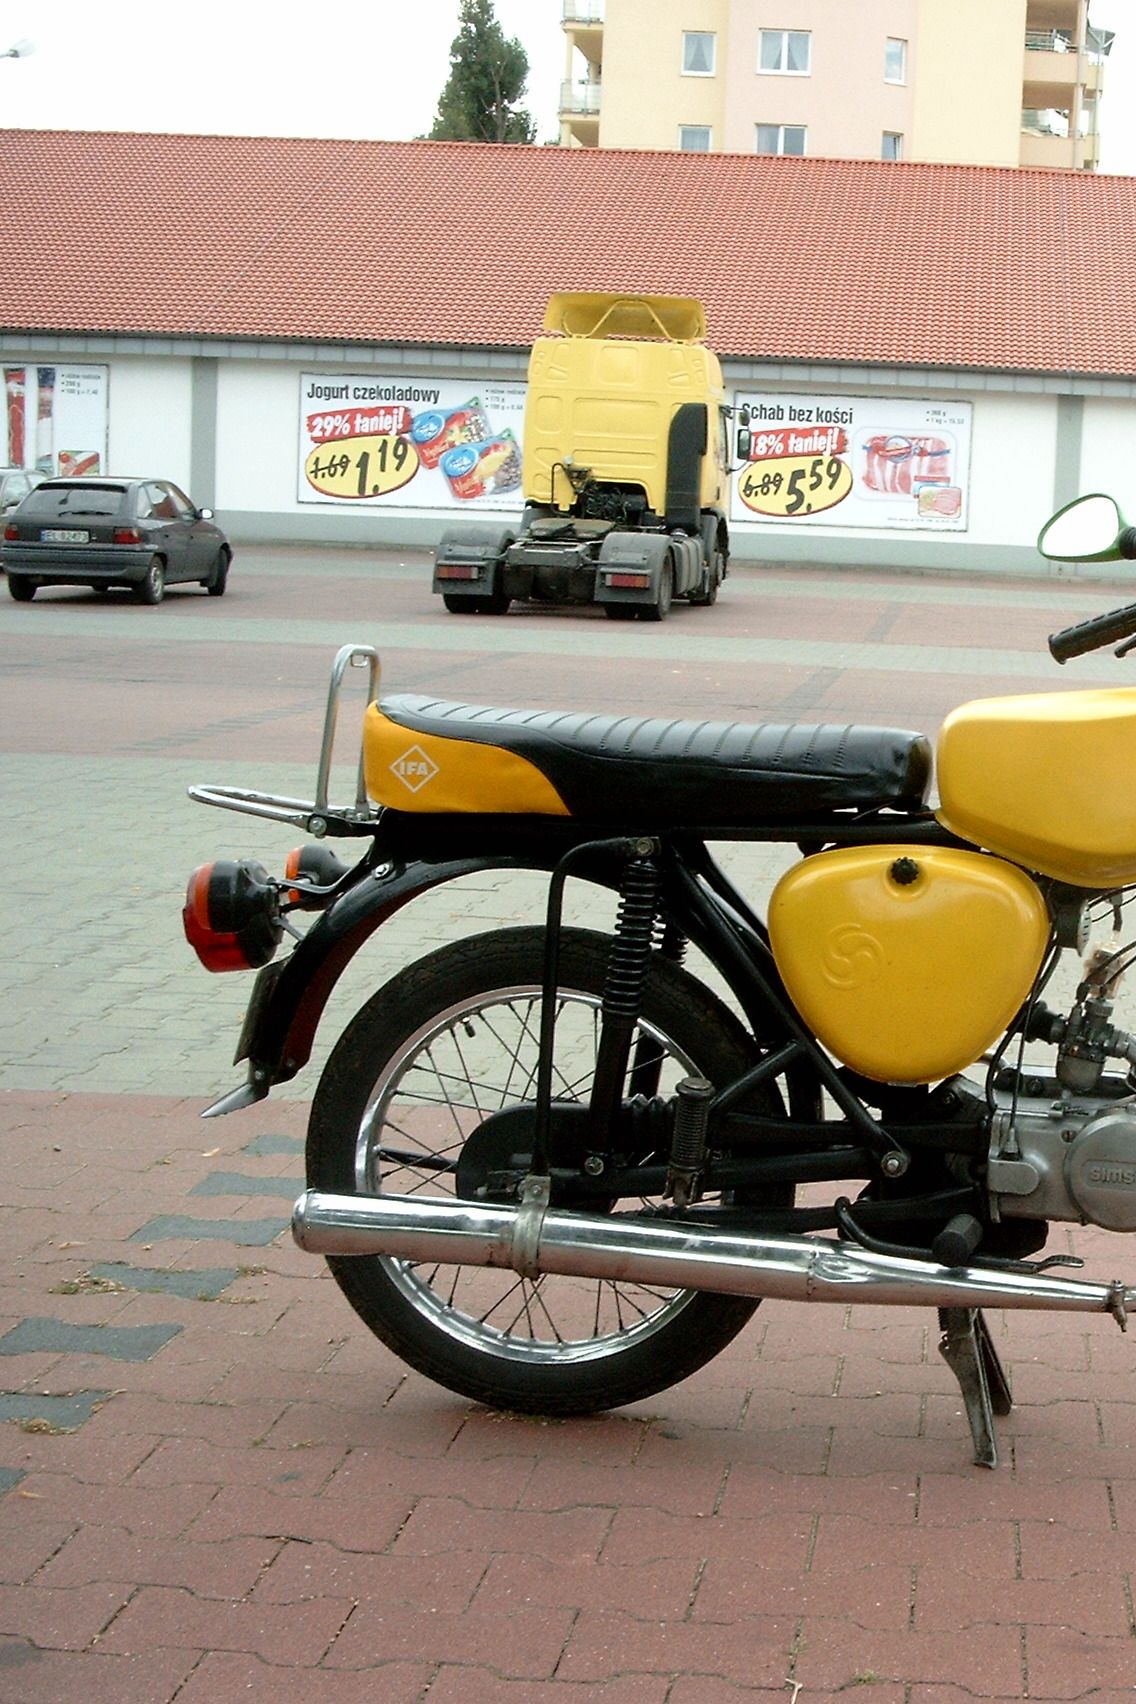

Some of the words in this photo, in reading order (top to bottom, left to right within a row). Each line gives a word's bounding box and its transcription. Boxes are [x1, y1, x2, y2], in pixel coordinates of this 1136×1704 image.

[307, 383, 349, 401] Jogurt
[353, 384, 440, 404] czekoladowy
[311, 413, 350, 437] 29%
[355, 407, 404, 436] taniej!
[742, 403, 784, 421] Schab
[789, 405, 812, 422] bez
[816, 407, 853, 424] kości
[788, 427, 838, 457] taniej!
